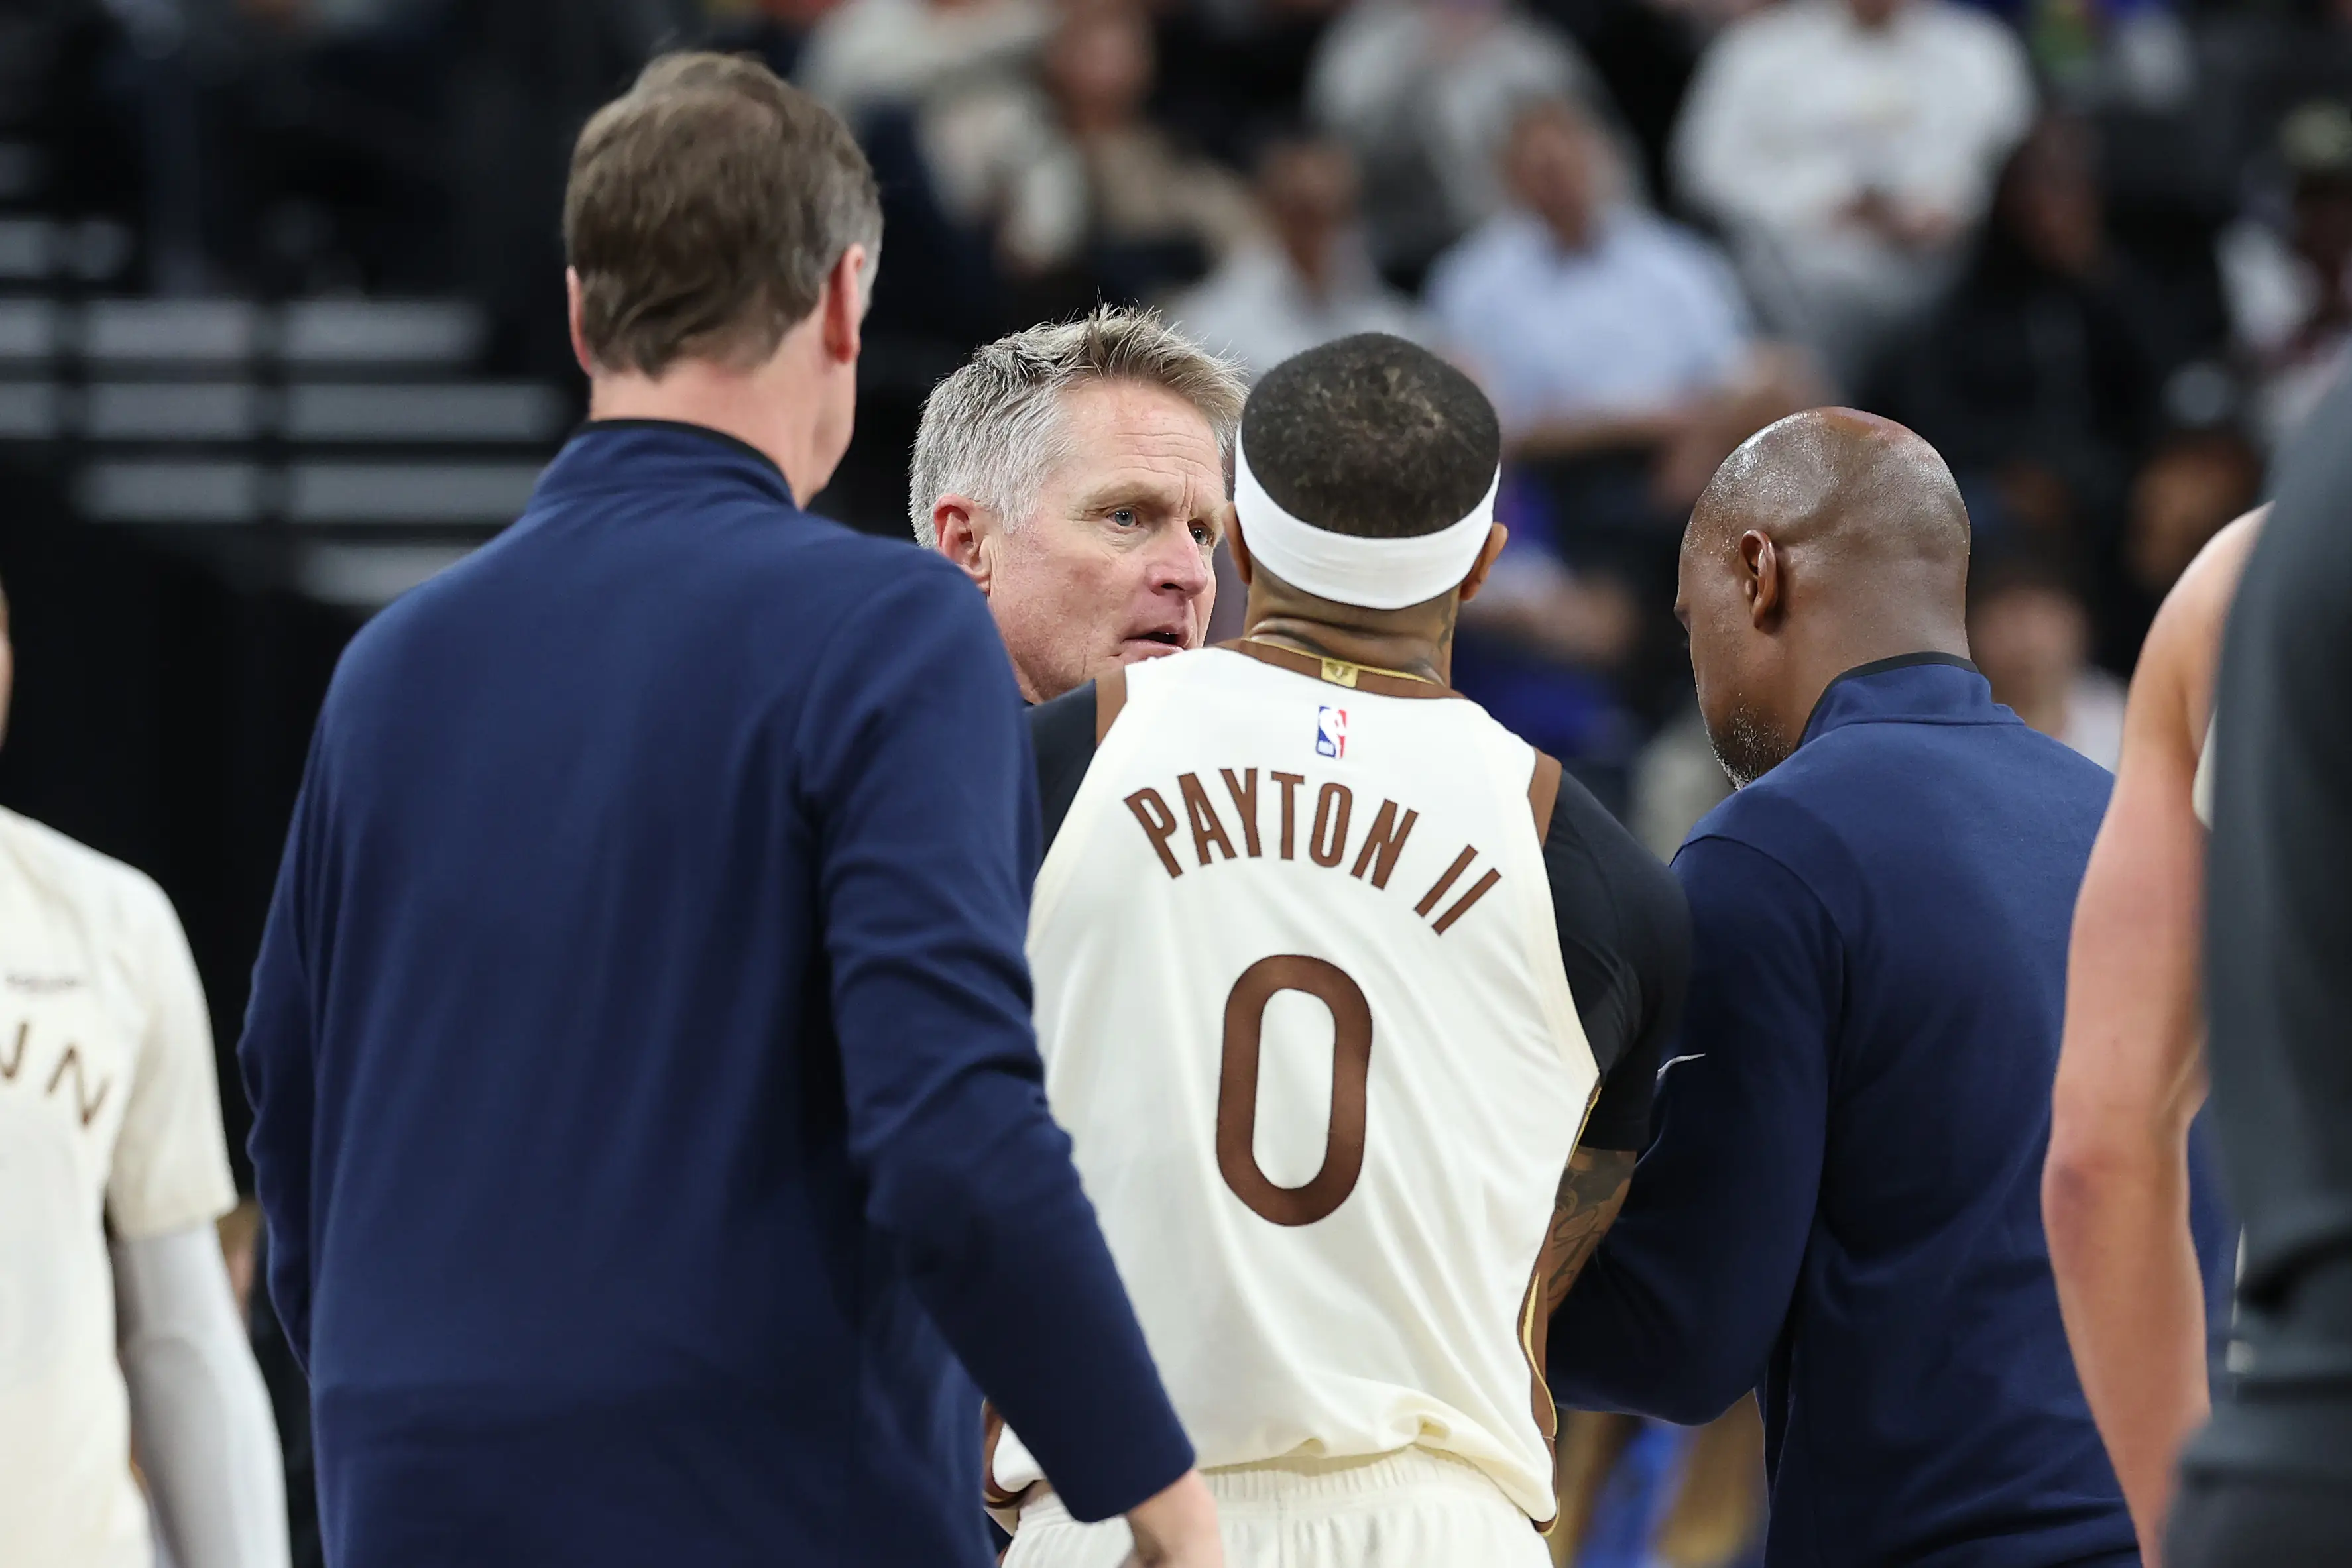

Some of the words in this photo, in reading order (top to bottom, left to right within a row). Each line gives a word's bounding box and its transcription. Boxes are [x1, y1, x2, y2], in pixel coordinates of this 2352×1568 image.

[1124, 767, 1419, 890] PAYTON
[1413, 844, 1501, 936] II
[1216, 954, 1372, 1227] 0
